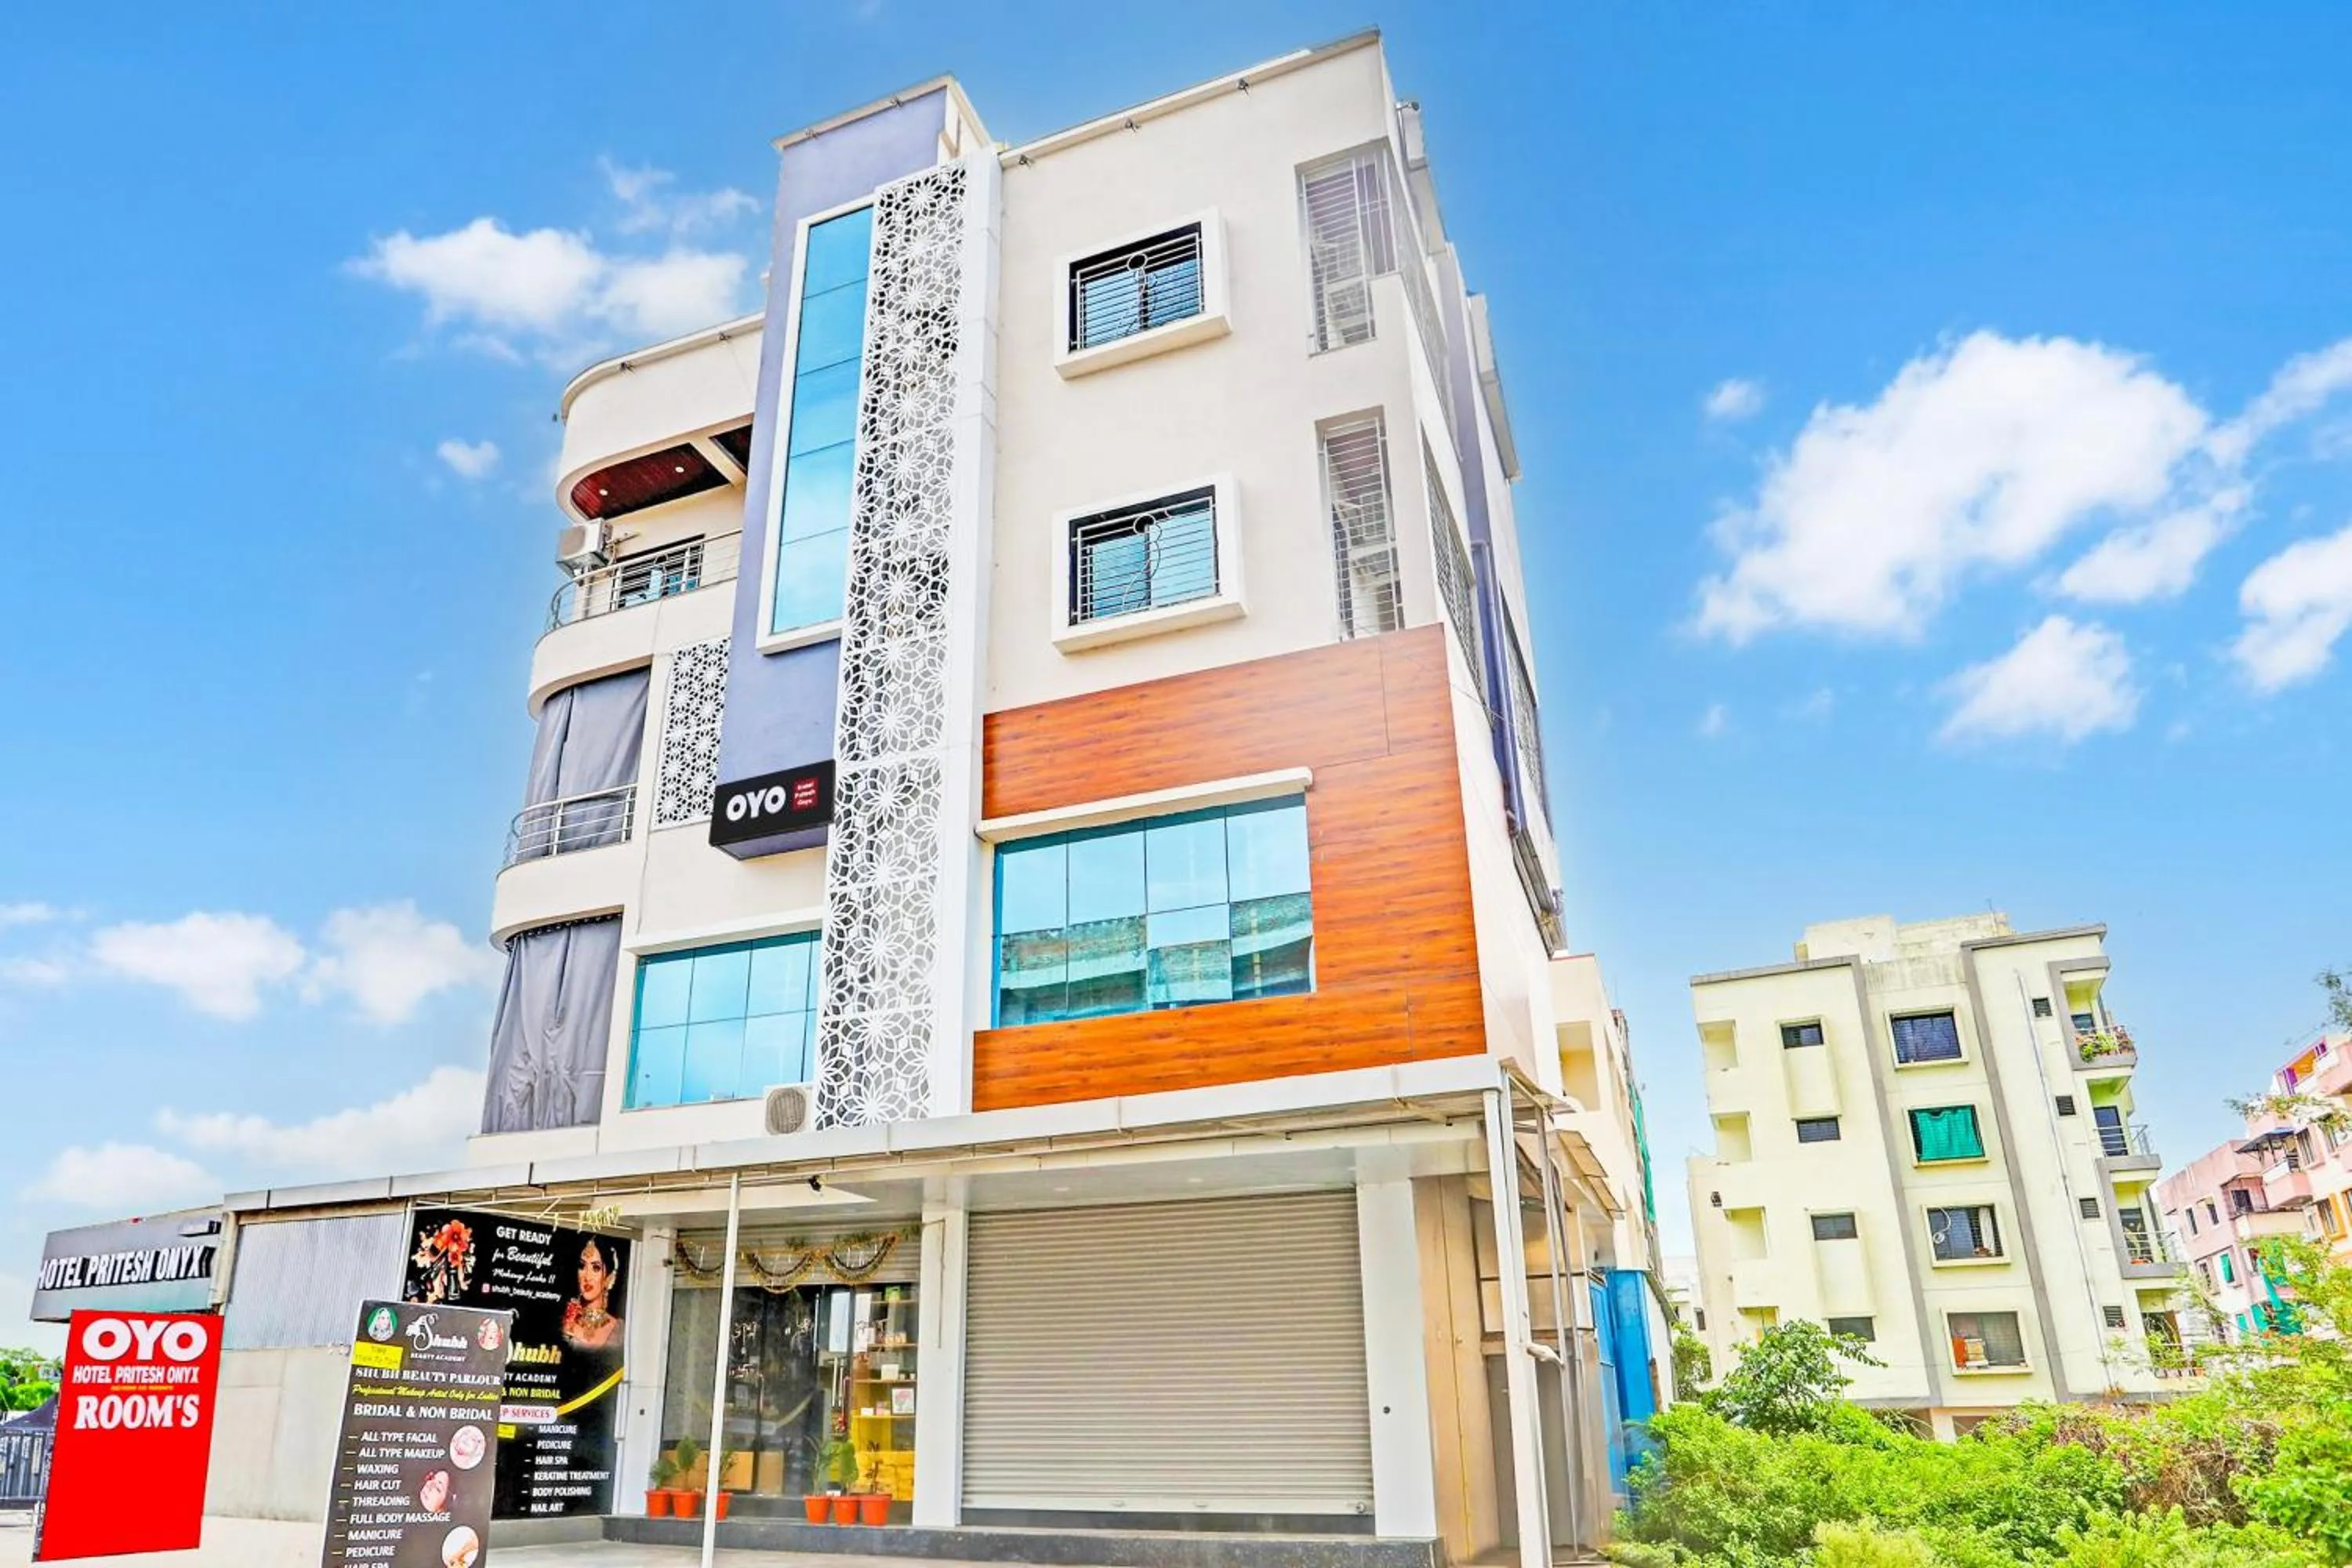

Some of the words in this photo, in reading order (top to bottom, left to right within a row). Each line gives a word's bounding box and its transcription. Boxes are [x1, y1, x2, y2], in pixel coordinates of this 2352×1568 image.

[727, 786, 786, 821] OYO
[496, 1225, 517, 1240] GET
[519, 1230, 553, 1245] READY
[492, 1248, 504, 1262] for
[506, 1246, 554, 1269] Beautiful
[39, 1257, 82, 1290] HOTEL
[85, 1249, 156, 1286] PRITESH
[155, 1245, 204, 1280] ONYX
[413, 1313, 468, 1351] Shubh
[82, 1318, 208, 1362] OYO
[410, 1352, 435, 1361] BEAUTY
[436, 1354, 466, 1363] ACADEMY
[73, 1365, 112, 1384] HOTEL
[115, 1367, 165, 1384] PRITESH
[167, 1367, 200, 1384] ONYX
[355, 1367, 401, 1380] SHUBH
[402, 1370, 447, 1382] BEAUTY
[449, 1372, 501, 1385] PARLOUR
[515, 1373, 557, 1384] ACADEMY
[510, 1388, 529, 1398] NON
[530, 1388, 561, 1399] BRIDAL
[74, 1394, 200, 1429] ROOM'S
[353, 1403, 402, 1417] BRIDAL
[405, 1405, 416, 1417] &
[418, 1406, 446, 1418] NON
[449, 1407, 494, 1421] BRIDAL
[511, 1409, 550, 1418] SERVICES
[538, 1425, 578, 1435] MANICURE
[361, 1431, 379, 1442] ALL
[381, 1432, 405, 1443] TYPE
[405, 1432, 438, 1443] FACIAL
[536, 1440, 572, 1450] PEDICURE
[358, 1447, 377, 1457] ALL
[379, 1448, 403, 1458] TYPE
[404, 1448, 446, 1459] MAKEUP
[535, 1456, 554, 1465] HAIR
[554, 1456, 568, 1465] SPA
[357, 1464, 400, 1475] WAXING
[534, 1471, 568, 1481] KERATINE
[570, 1471, 611, 1481] TREATMENT
[354, 1479, 380, 1490] HAIR
[381, 1479, 402, 1490] CUT
[532, 1487, 553, 1497] BODY
[554, 1486, 592, 1497] POLISHING
[353, 1496, 410, 1507] THREADING
[530, 1503, 549, 1513] NAIL
[549, 1502, 565, 1512] ART
[350, 1513, 374, 1525] FULL
[376, 1512, 404, 1523] BODY
[405, 1512, 452, 1523] MASSAGE
[347, 1529, 403, 1541] MANICURE
[345, 1545, 396, 1558] PEDICURE
